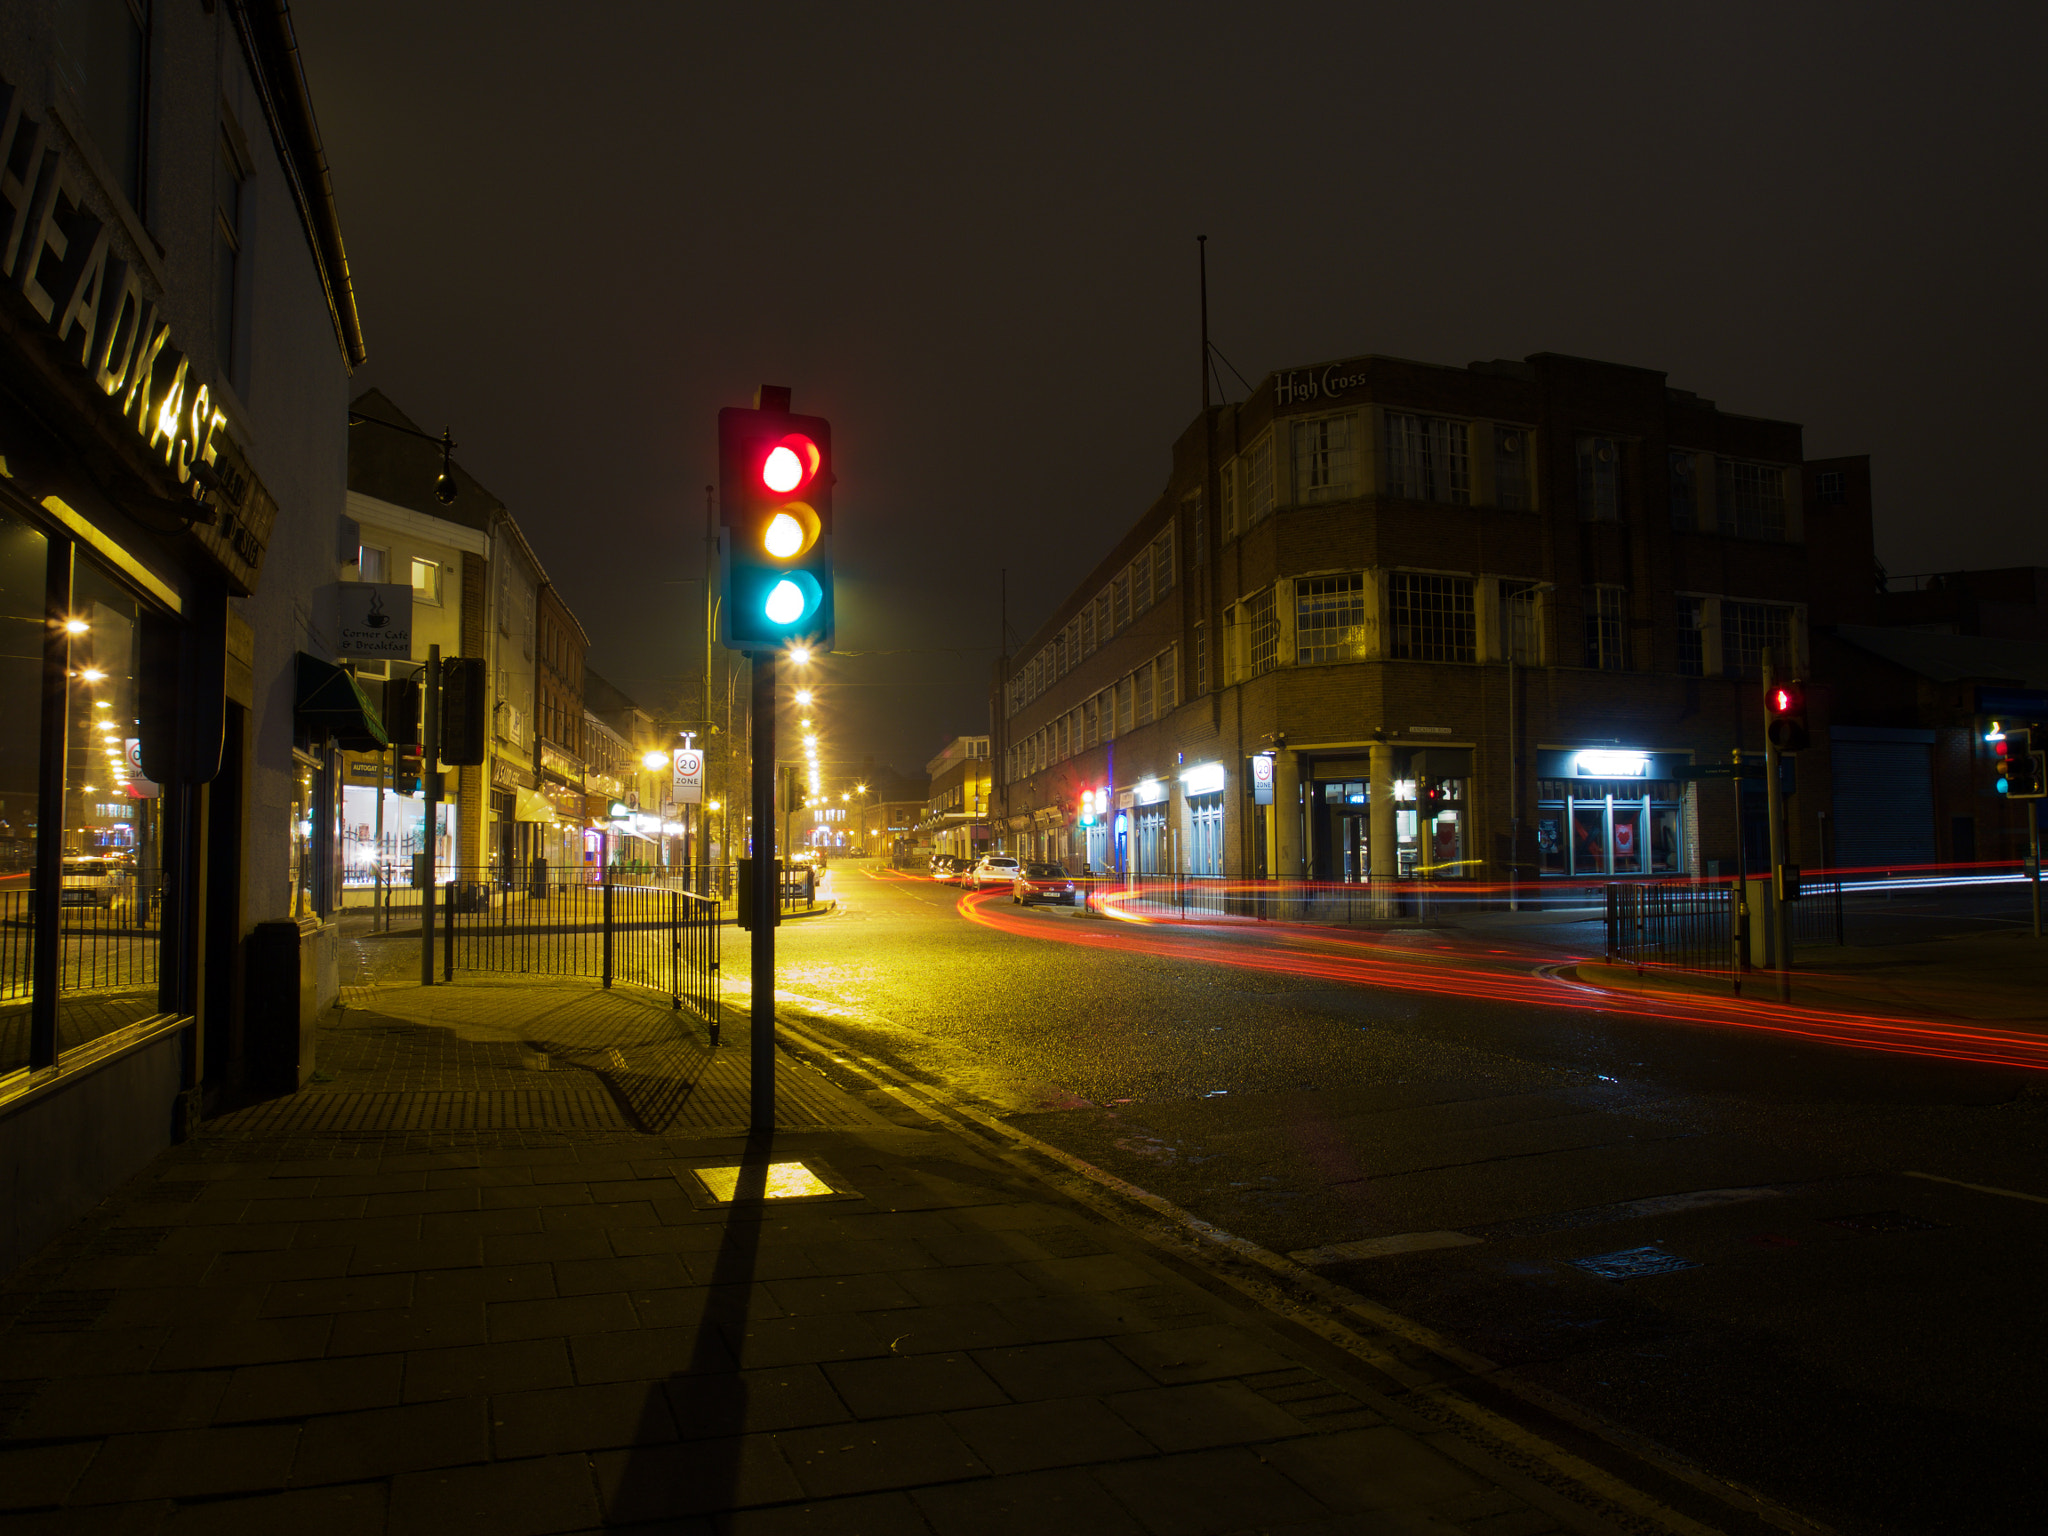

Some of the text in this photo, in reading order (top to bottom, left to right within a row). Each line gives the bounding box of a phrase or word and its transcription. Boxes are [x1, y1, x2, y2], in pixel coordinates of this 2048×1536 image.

[0, 78, 228, 502] HEADKASE
[1274, 363, 1367, 406] High Cross
[343, 629, 380, 638] Corner
[357, 641, 408, 651] Breakfast
[353, 764, 379, 772] AUTOGAT
[680, 760, 696, 769] 20
[1258, 765, 1268, 774] 20
[676, 777, 698, 785] ZONE
